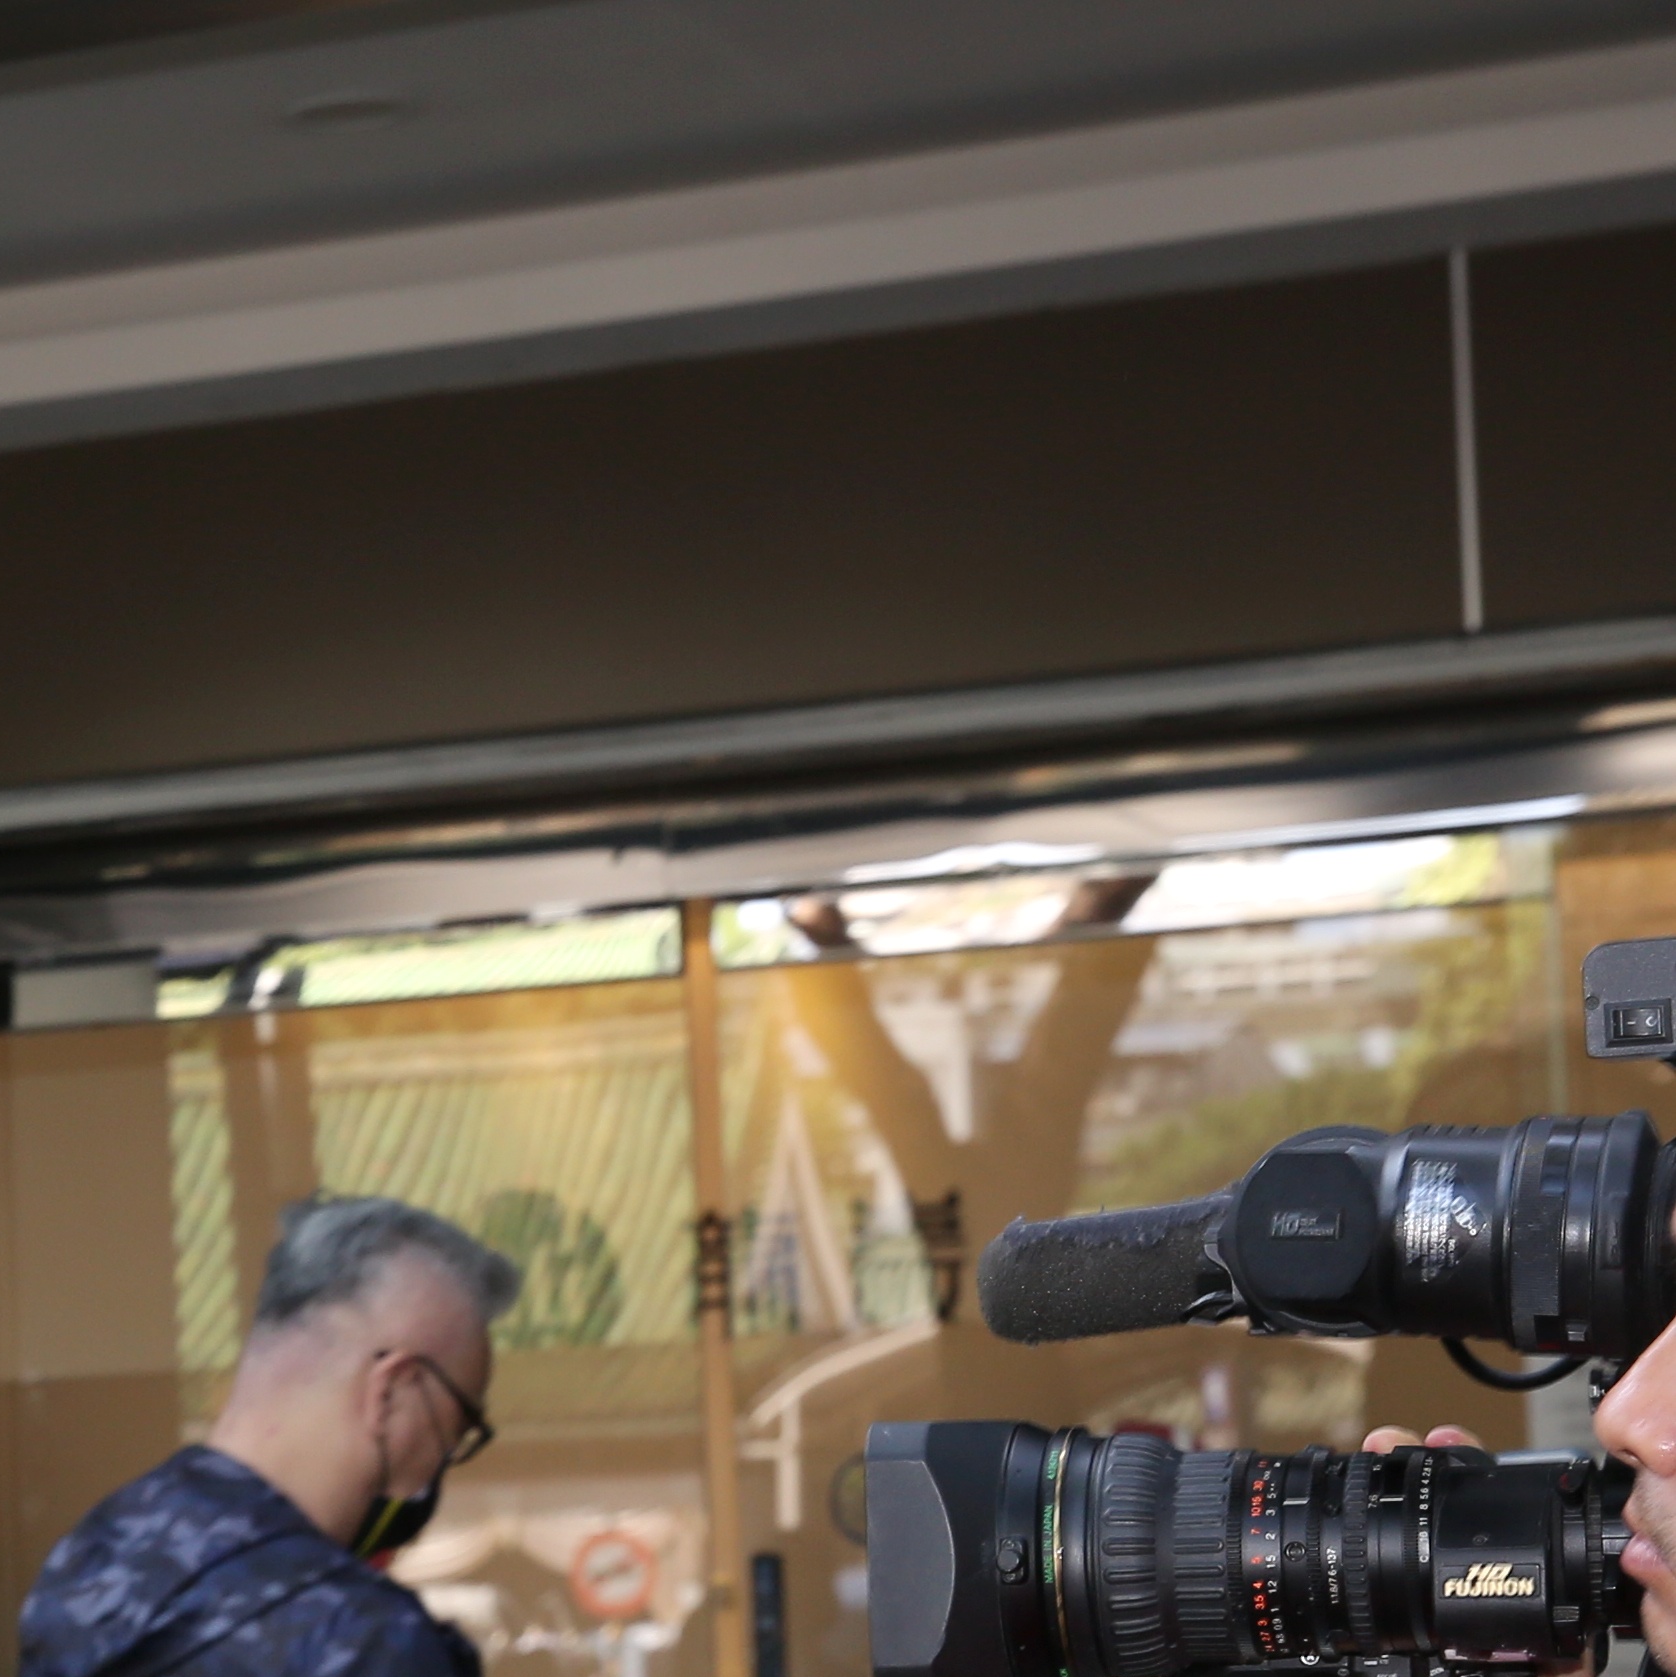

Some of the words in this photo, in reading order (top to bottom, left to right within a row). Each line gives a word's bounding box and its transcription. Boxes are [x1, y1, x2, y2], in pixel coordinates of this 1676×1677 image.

[1265, 1508, 1276, 1516] 3
[1044, 1504, 1054, 1536] JAPAN
[1419, 1517, 1428, 1526] 11
[1250, 1527, 1261, 1535] 7
[1265, 1532, 1276, 1540] 2
[1252, 1581, 1263, 1589] 4
[1443, 1577, 1536, 1598] FUJINON
